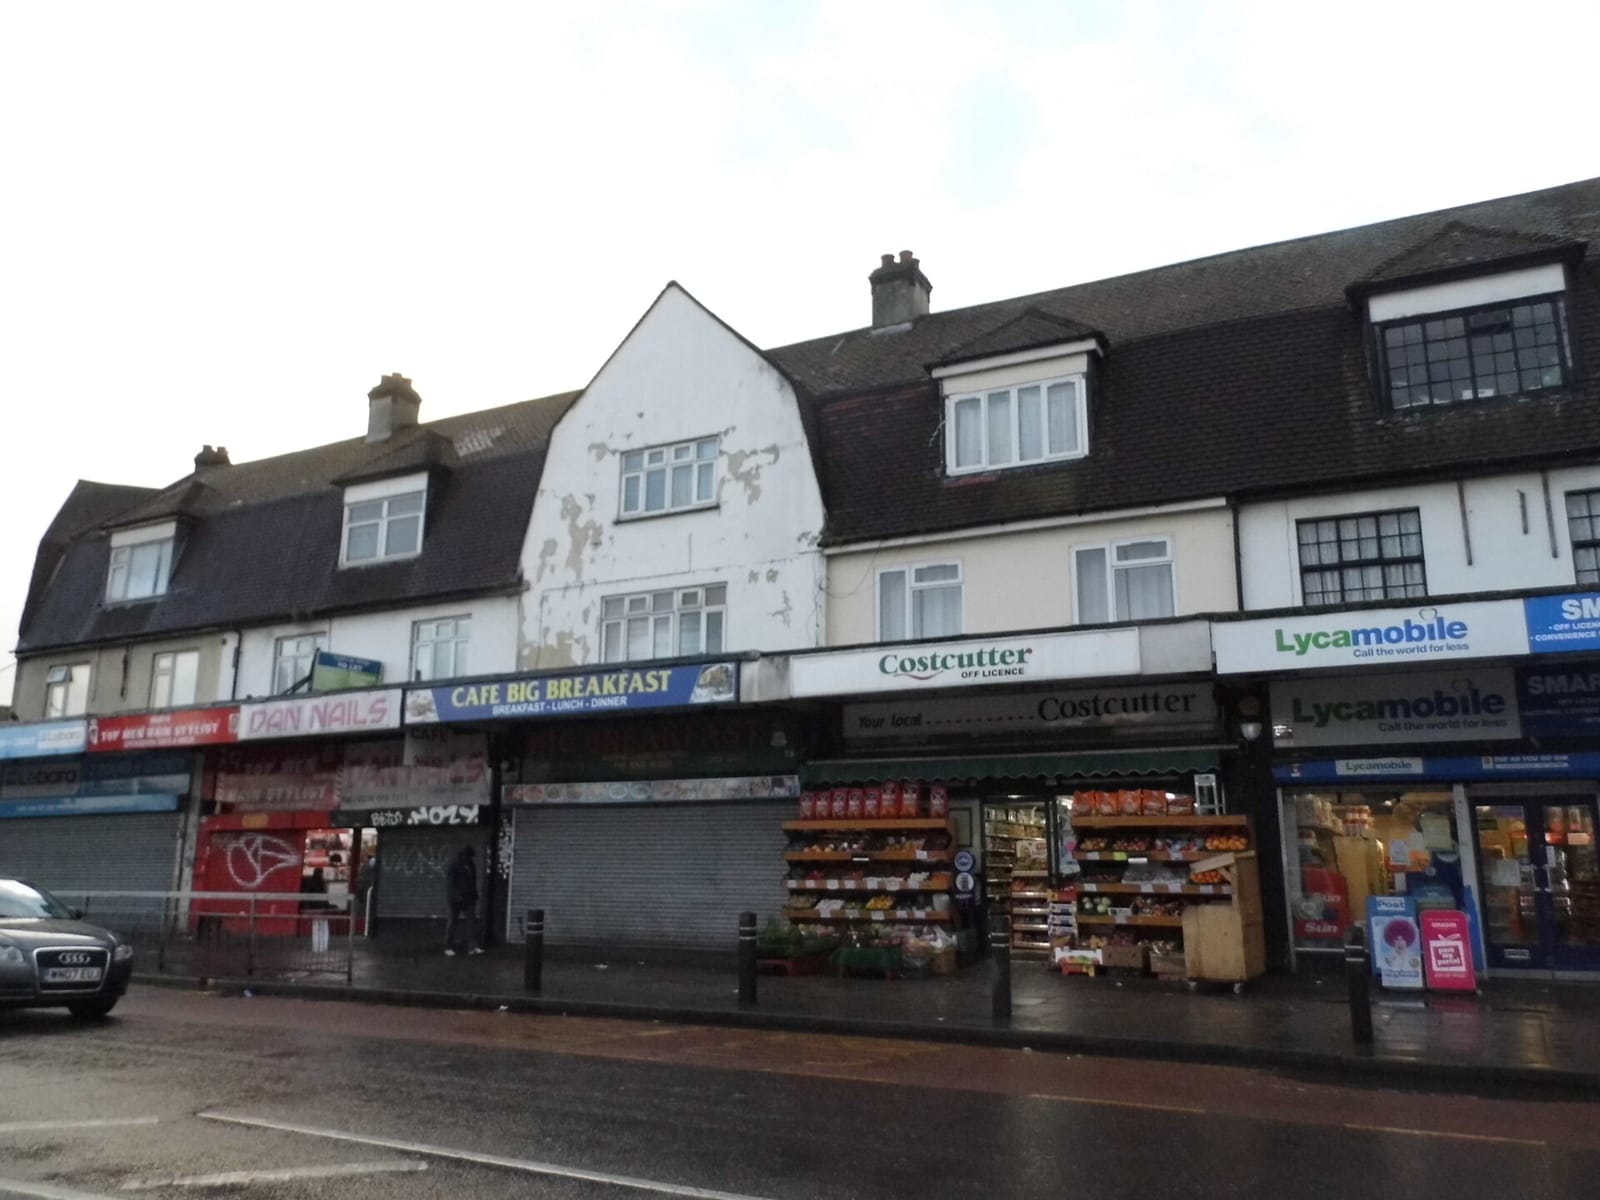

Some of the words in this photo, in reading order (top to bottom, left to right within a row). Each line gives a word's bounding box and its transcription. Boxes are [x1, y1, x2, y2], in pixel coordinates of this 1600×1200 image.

[1554, 623, 1570, 631] OFF
[1275, 616, 1468, 655] Lycamobile
[1535, 631, 1597, 641] CONVENIENCE
[1353, 649, 1374, 658] Call
[1376, 647, 1394, 656] the
[1396, 645, 1427, 654] world
[1429, 643, 1443, 653] for
[1446, 642, 1469, 651] less
[879, 647, 1030, 675] Costcutter
[961, 670, 979, 679] OFF
[982, 667, 1024, 677] LICENCE
[452, 687, 499, 708] CAFE
[507, 681, 539, 702] BIG
[546, 670, 672, 699] BREAKFAST
[492, 702, 545, 716] BREAKFAST
[552, 700, 583, 712] LUNCH
[591, 696, 628, 709] DINNER
[859, 715, 884, 729] Your
[891, 713, 923, 728] local
[1038, 691, 1197, 722] Costcutter
[1293, 690, 1505, 727] Lycamobile
[250, 704, 305, 735] DAN
[310, 697, 389, 729] NAILS
[174, 720, 220, 736] STYLIST
[1379, 720, 1401, 732] Call
[1346, 759, 1412, 772] Lycamobile
[1304, 922, 1338, 934] Sun
